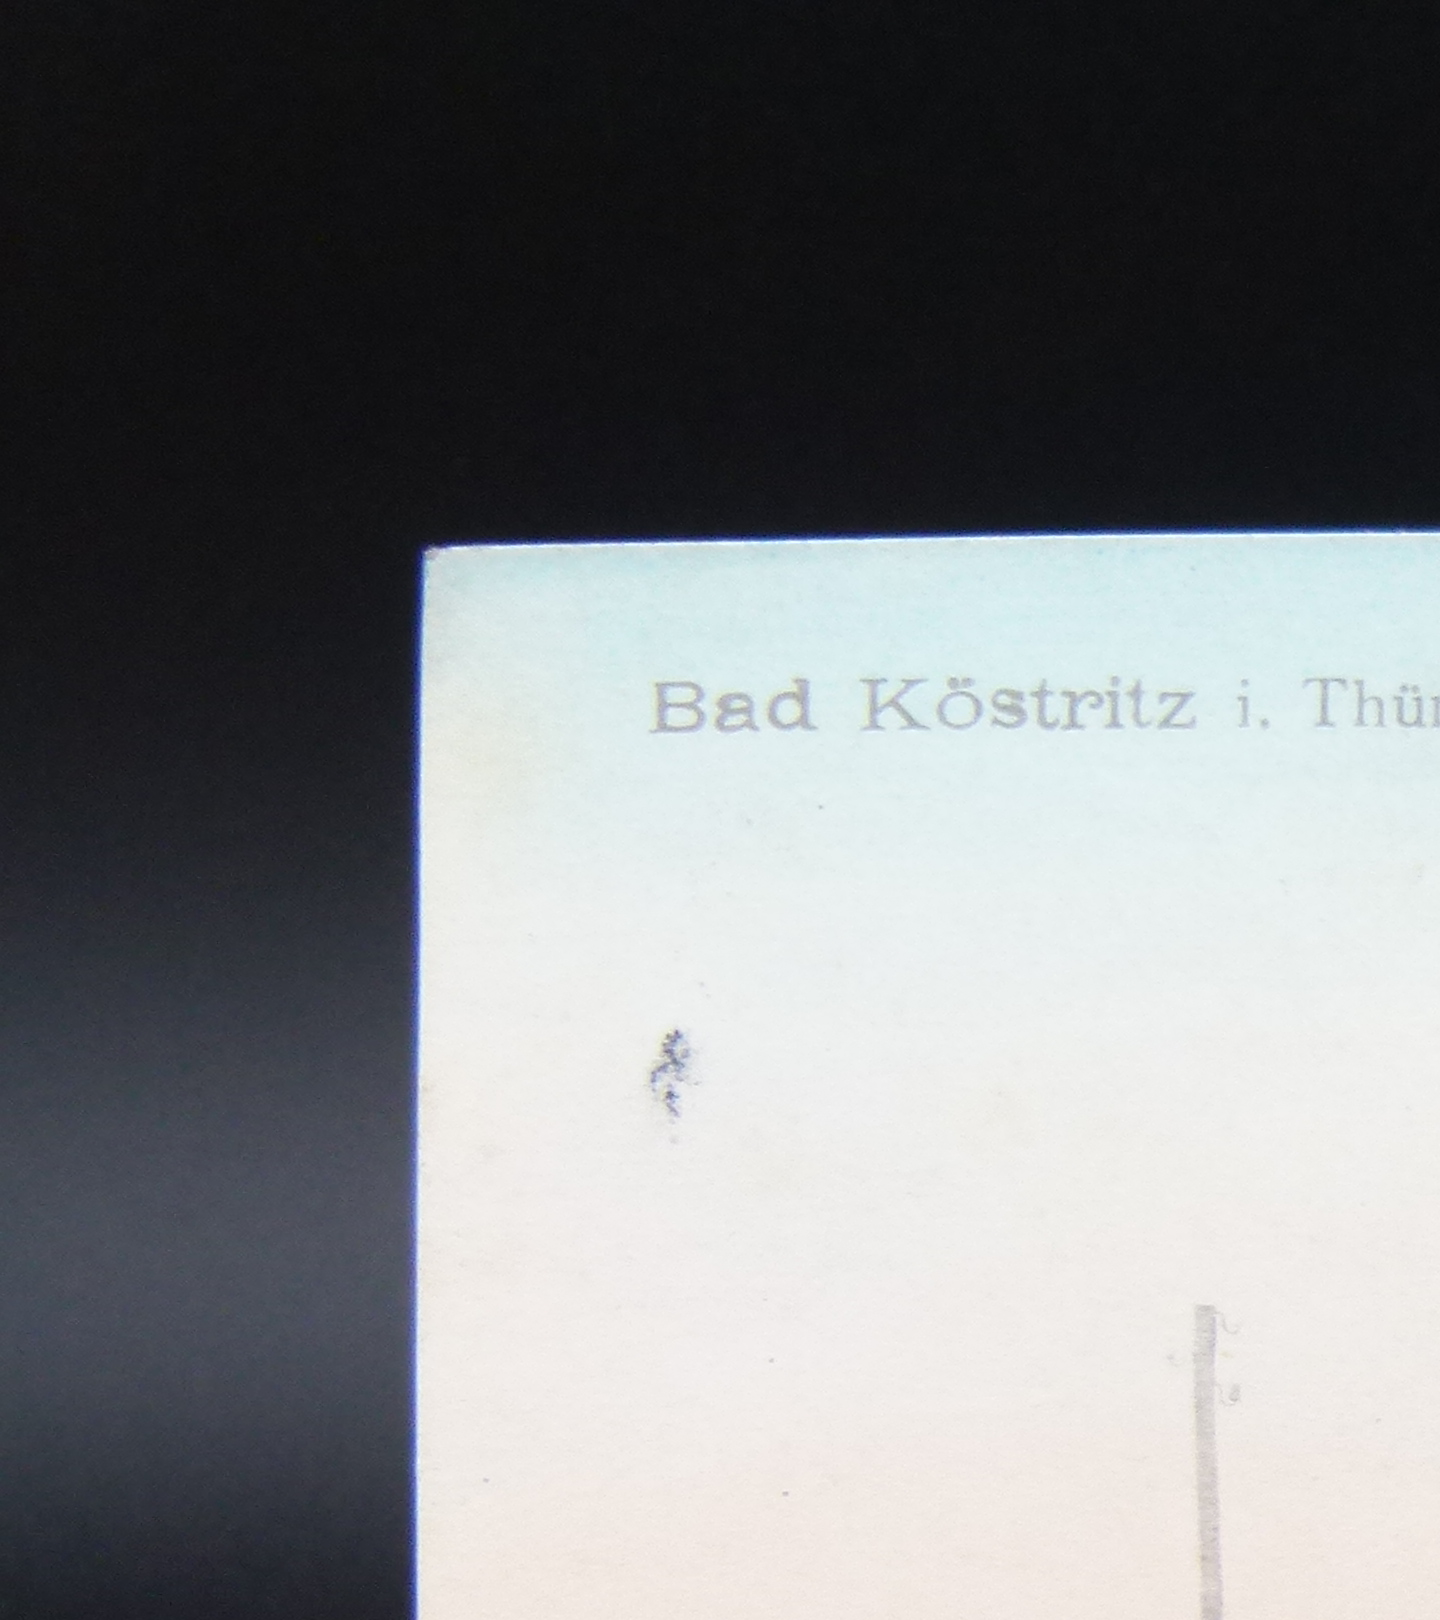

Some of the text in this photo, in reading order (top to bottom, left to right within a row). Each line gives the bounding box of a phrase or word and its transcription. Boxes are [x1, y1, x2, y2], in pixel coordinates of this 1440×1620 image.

[649, 678, 818, 734] Bad
[859, 677, 1196, 732] Köstritz
[1237, 679, 1270, 730] i.
